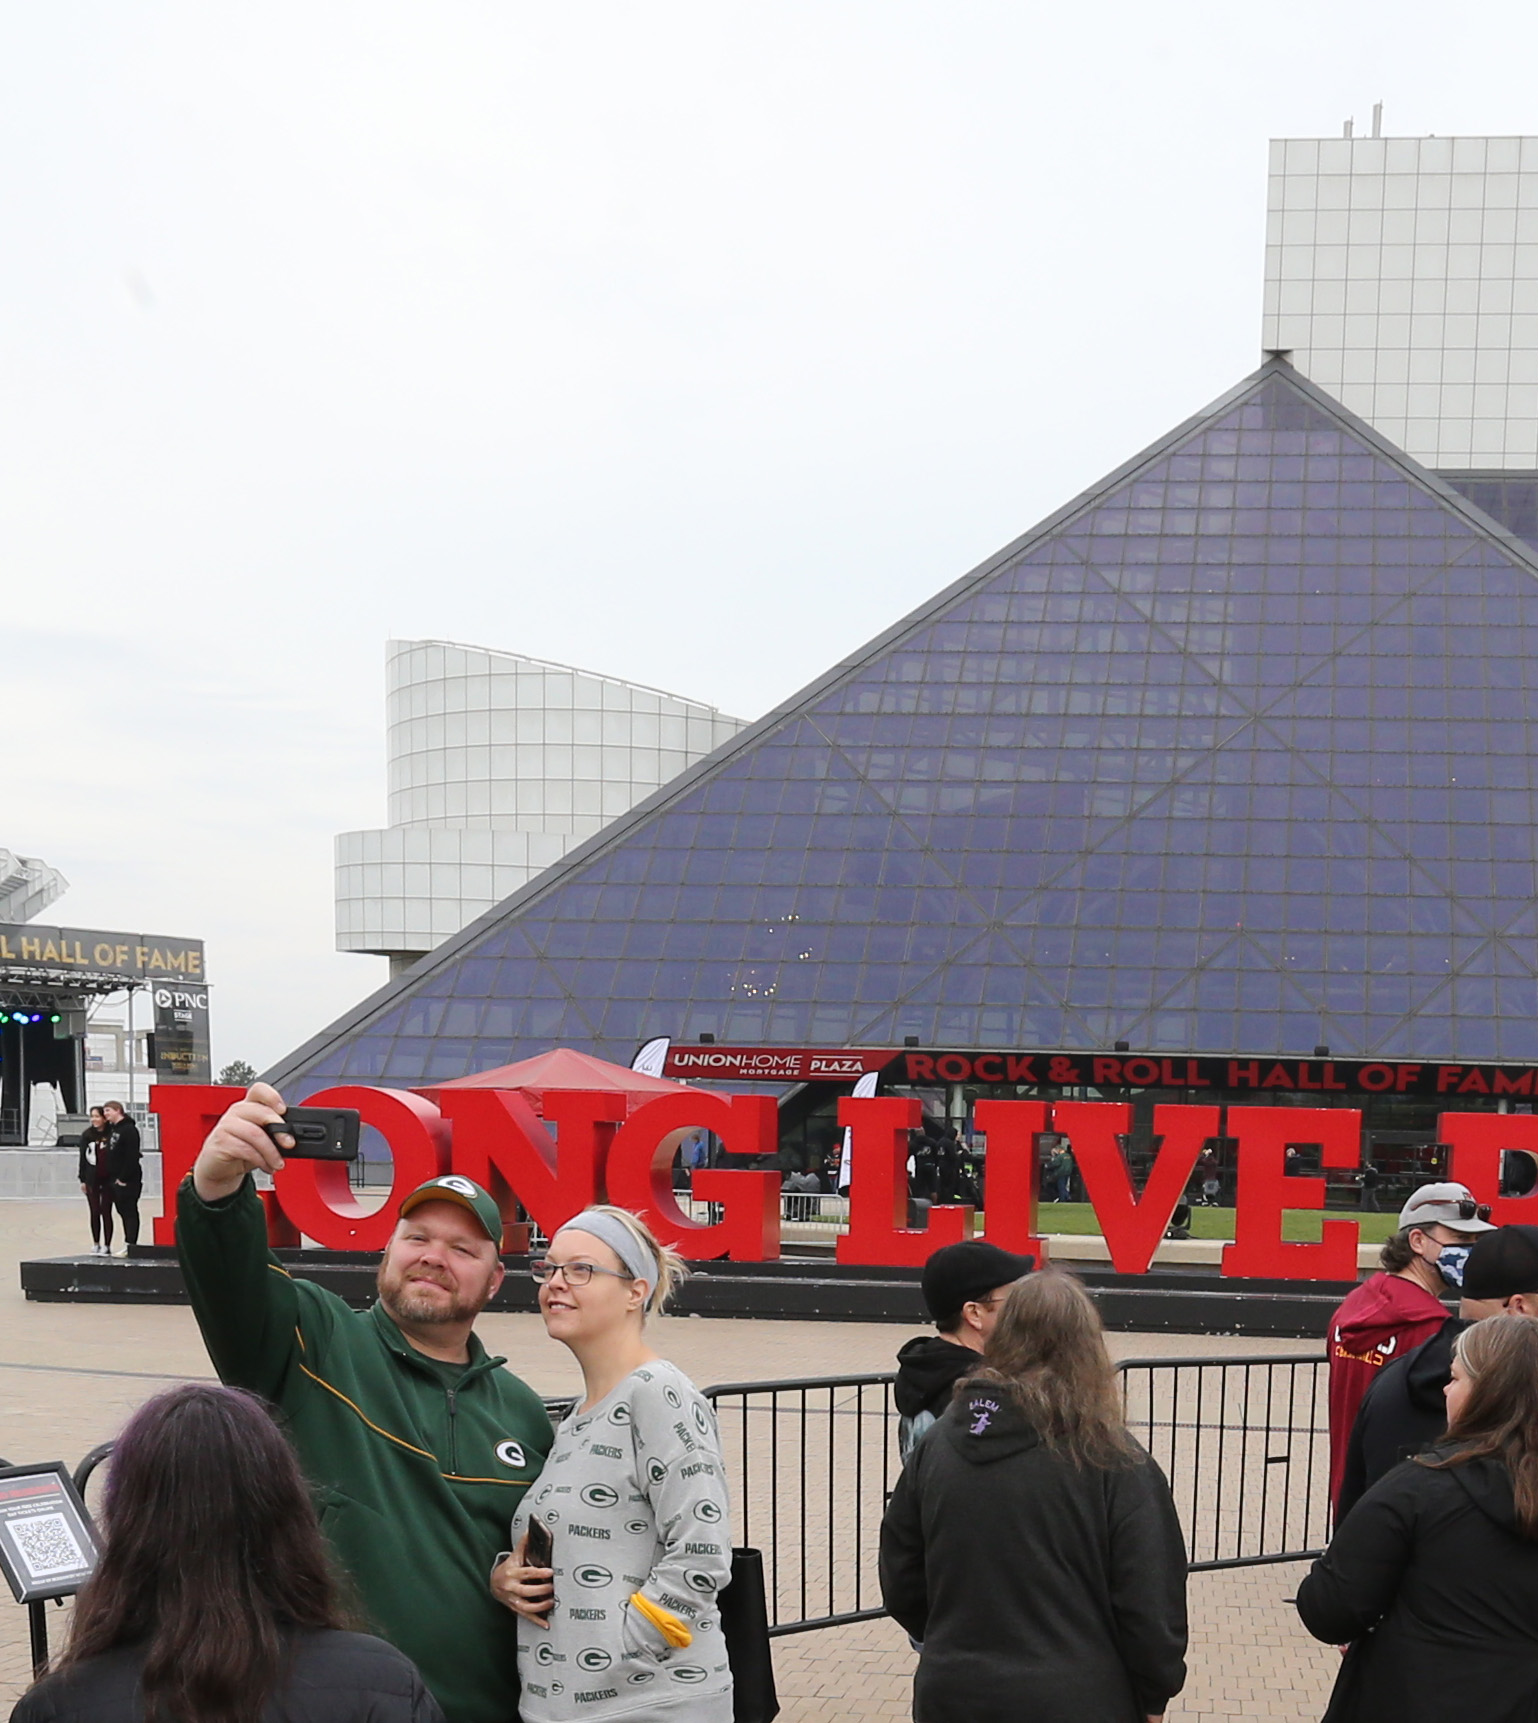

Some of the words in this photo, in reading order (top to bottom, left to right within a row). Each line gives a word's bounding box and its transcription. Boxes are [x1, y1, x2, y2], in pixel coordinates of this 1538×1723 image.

[21, 936, 89, 965] HALL
[94, 943, 129, 967] OF
[135, 946, 201, 973] FAME
[172, 992, 208, 1009] PNC
[739, 1068, 799, 1076] MORTGAGE
[810, 1059, 863, 1072] PLAZA
[905, 1053, 1038, 1082] ROCK
[1048, 1055, 1081, 1084] &
[1092, 1057, 1210, 1086] ROLL
[1227, 1060, 1347, 1090] HALL
[1357, 1063, 1421, 1092] OF
[836, 1097, 1362, 1282] LIVE
[588, 1443, 624, 1460] PACKERS
[568, 1523, 611, 1541] PACKERS
[569, 1608, 607, 1621] PACKERS
[658, 1592, 698, 1620] PACKERS
[574, 1687, 619, 1704] PACKERS
